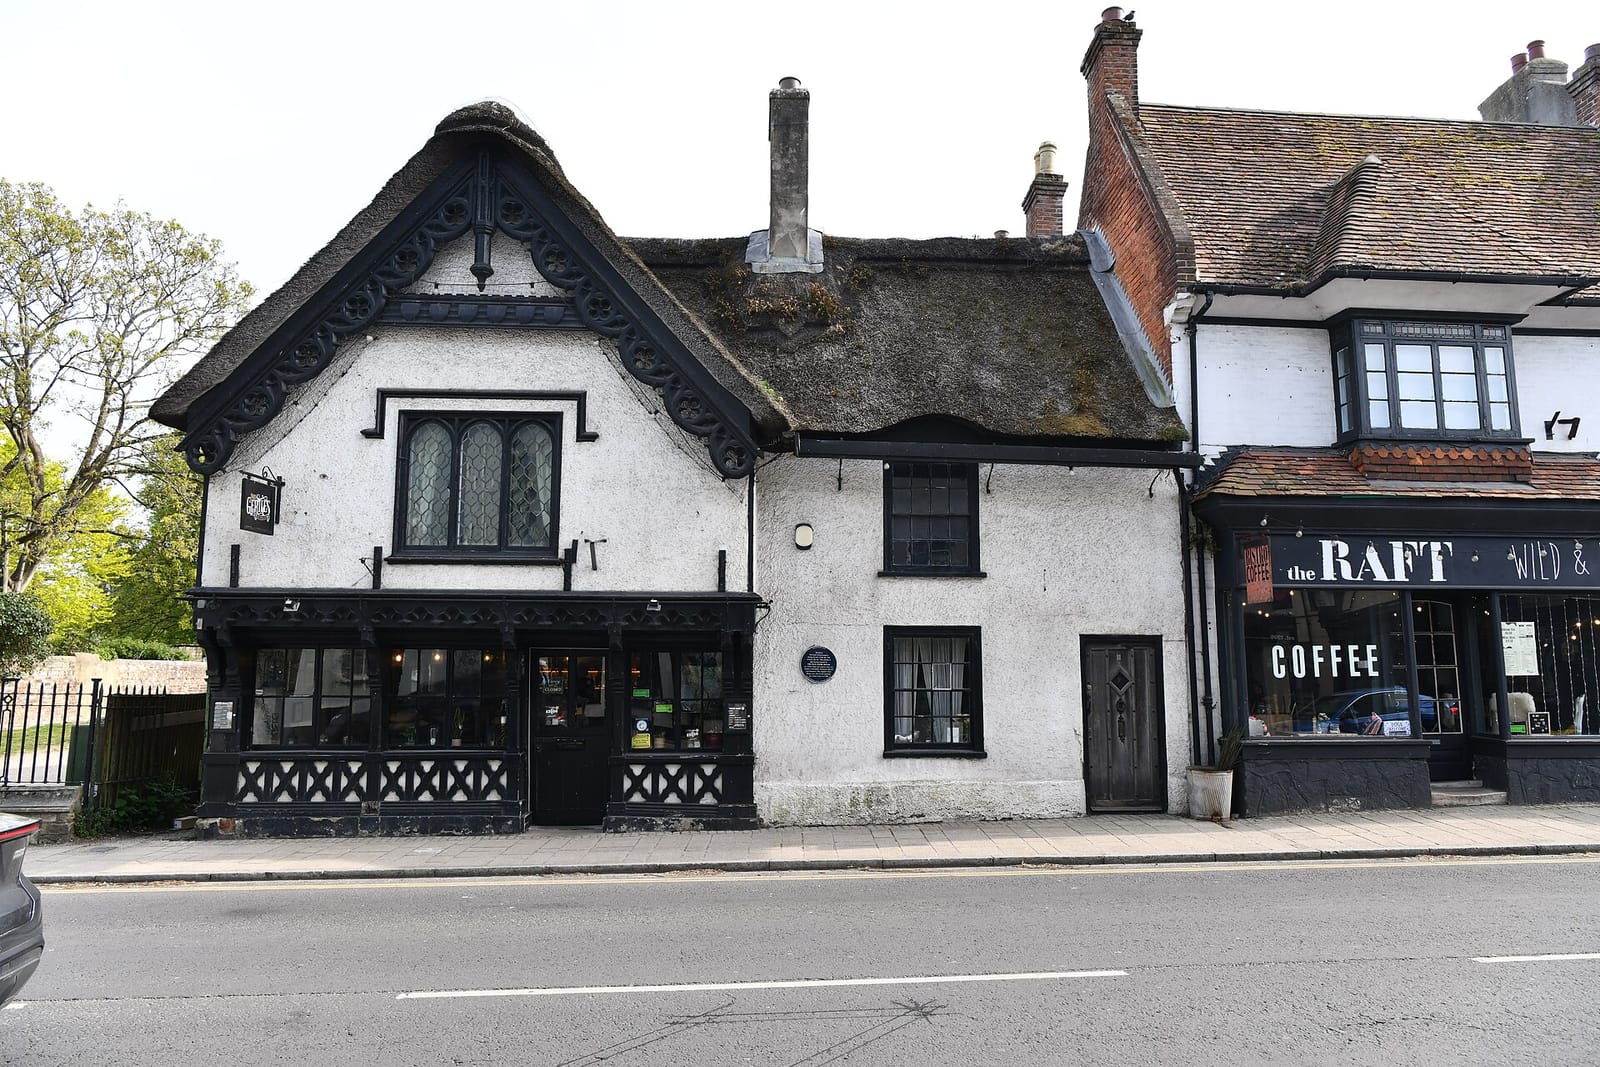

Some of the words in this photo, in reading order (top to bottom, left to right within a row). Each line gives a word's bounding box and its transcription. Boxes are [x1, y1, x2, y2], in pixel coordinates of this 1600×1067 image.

[1246, 563, 1270, 583] COFFEE
[1287, 566, 1316, 581] the
[1319, 539, 1453, 582] RAFT
[1511, 541, 1560, 580] WILD
[1573, 549, 1590, 575] &
[1271, 644, 1380, 679] COFFEE
